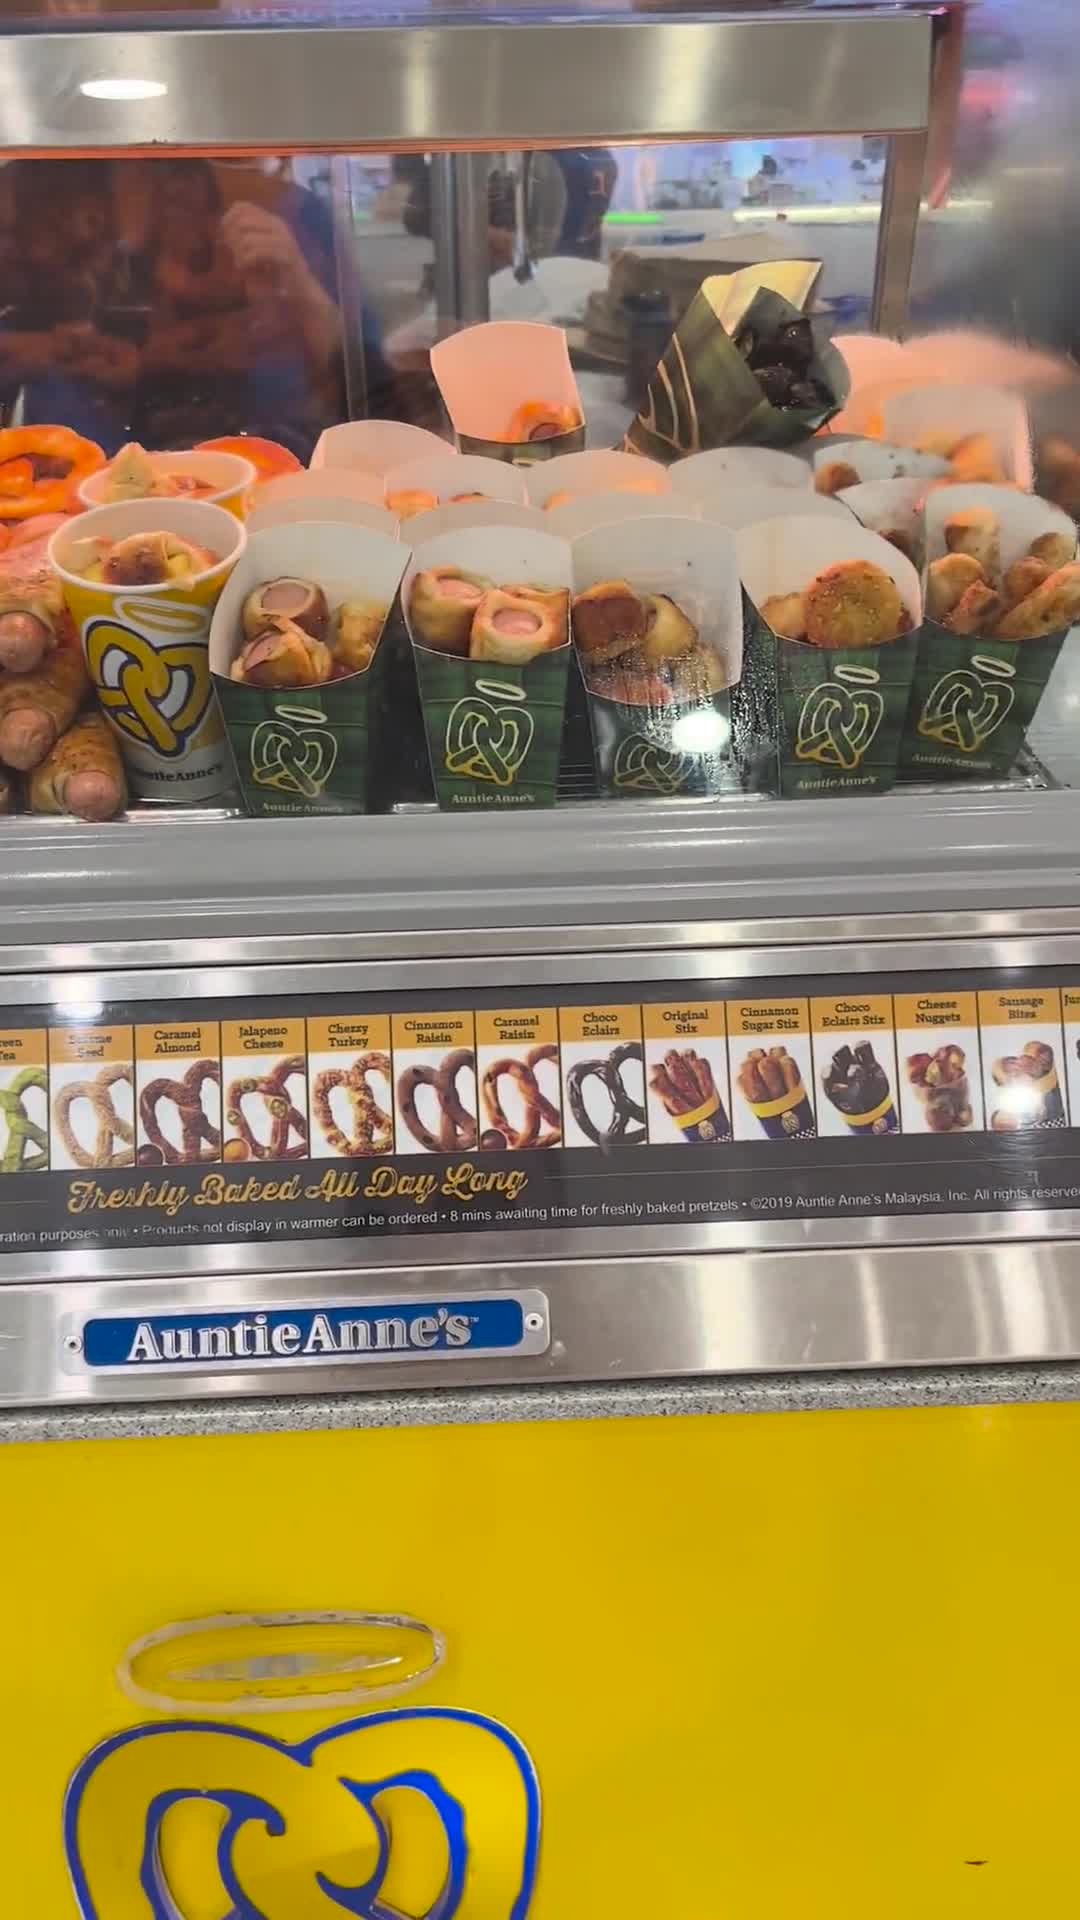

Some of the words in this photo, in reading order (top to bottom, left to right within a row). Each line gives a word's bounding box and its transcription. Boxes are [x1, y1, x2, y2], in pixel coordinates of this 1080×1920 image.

[451, 793, 536, 805] AuntieAnne's
[835, 1002, 871, 1014] Choco
[917, 999, 958, 1010] Cheese
[583, 1012, 618, 1023] Choco
[662, 1009, 709, 1023] Original
[740, 1006, 799, 1018] Cinnamon
[1008, 1008, 1037, 1020] Bites
[493, 1015, 540, 1027] Caramel
[742, 1020, 774, 1032] Sugar
[776, 1018, 799, 1029] Stix
[822, 1016, 860, 1027] Eclairs
[862, 1014, 886, 1025] Stix
[916, 1013, 961, 1025] Nuggets
[404, 1020, 463, 1031] Cinnamon
[583, 1025, 620, 1036] Eclairs
[675, 1023, 698, 1034] Stix
[154, 1030, 201, 1041] Caramel
[238, 1025, 288, 1039] Jalapeno
[416, 1032, 453, 1043] Raisin
[500, 1028, 536, 1040] Raisin
[154, 1041, 201, 1054] Almond
[243, 1038, 284, 1050] Cheese
[328, 1036, 369, 1048] Turkey
[67, 1179, 190, 1216] Freshly
[194, 1172, 301, 1207] Baked
[304, 1168, 361, 1203] All
[363, 1165, 438, 1205] Day
[441, 1161, 528, 1200] Long
[39, 1228, 99, 1244] purposes
[142, 1224, 201, 1236] Products
[204, 1221, 224, 1234] not
[226, 1219, 273, 1237] display
[276, 1219, 287, 1231] in
[290, 1219, 338, 1230] warmer
[341, 1215, 366, 1227] can
[368, 1211, 386, 1226] be
[387, 1210, 438, 1226] ordered
[449, 1210, 459, 1222] 8
[461, 1209, 492, 1222] mins
[495, 1206, 548, 1222] awaiting
[551, 1207, 578, 1218] time
[581, 1204, 598, 1216] for
[600, 1201, 644, 1218] freshly
[646, 1200, 686, 1214] baked
[688, 1199, 739, 1214] pretzels
[750, 1196, 793, 1209] ©2019
[795, 1195, 835, 1208] Auntie
[838, 1193, 882, 1206] Anne's
[948, 1190, 970, 1201] Inc.
[974, 1188, 990, 1200] All
[993, 1187, 1029, 1202] rights
[1031, 1186, 1080, 1199] reserve
[126, 1308, 472, 1361] AuntieAnne's
